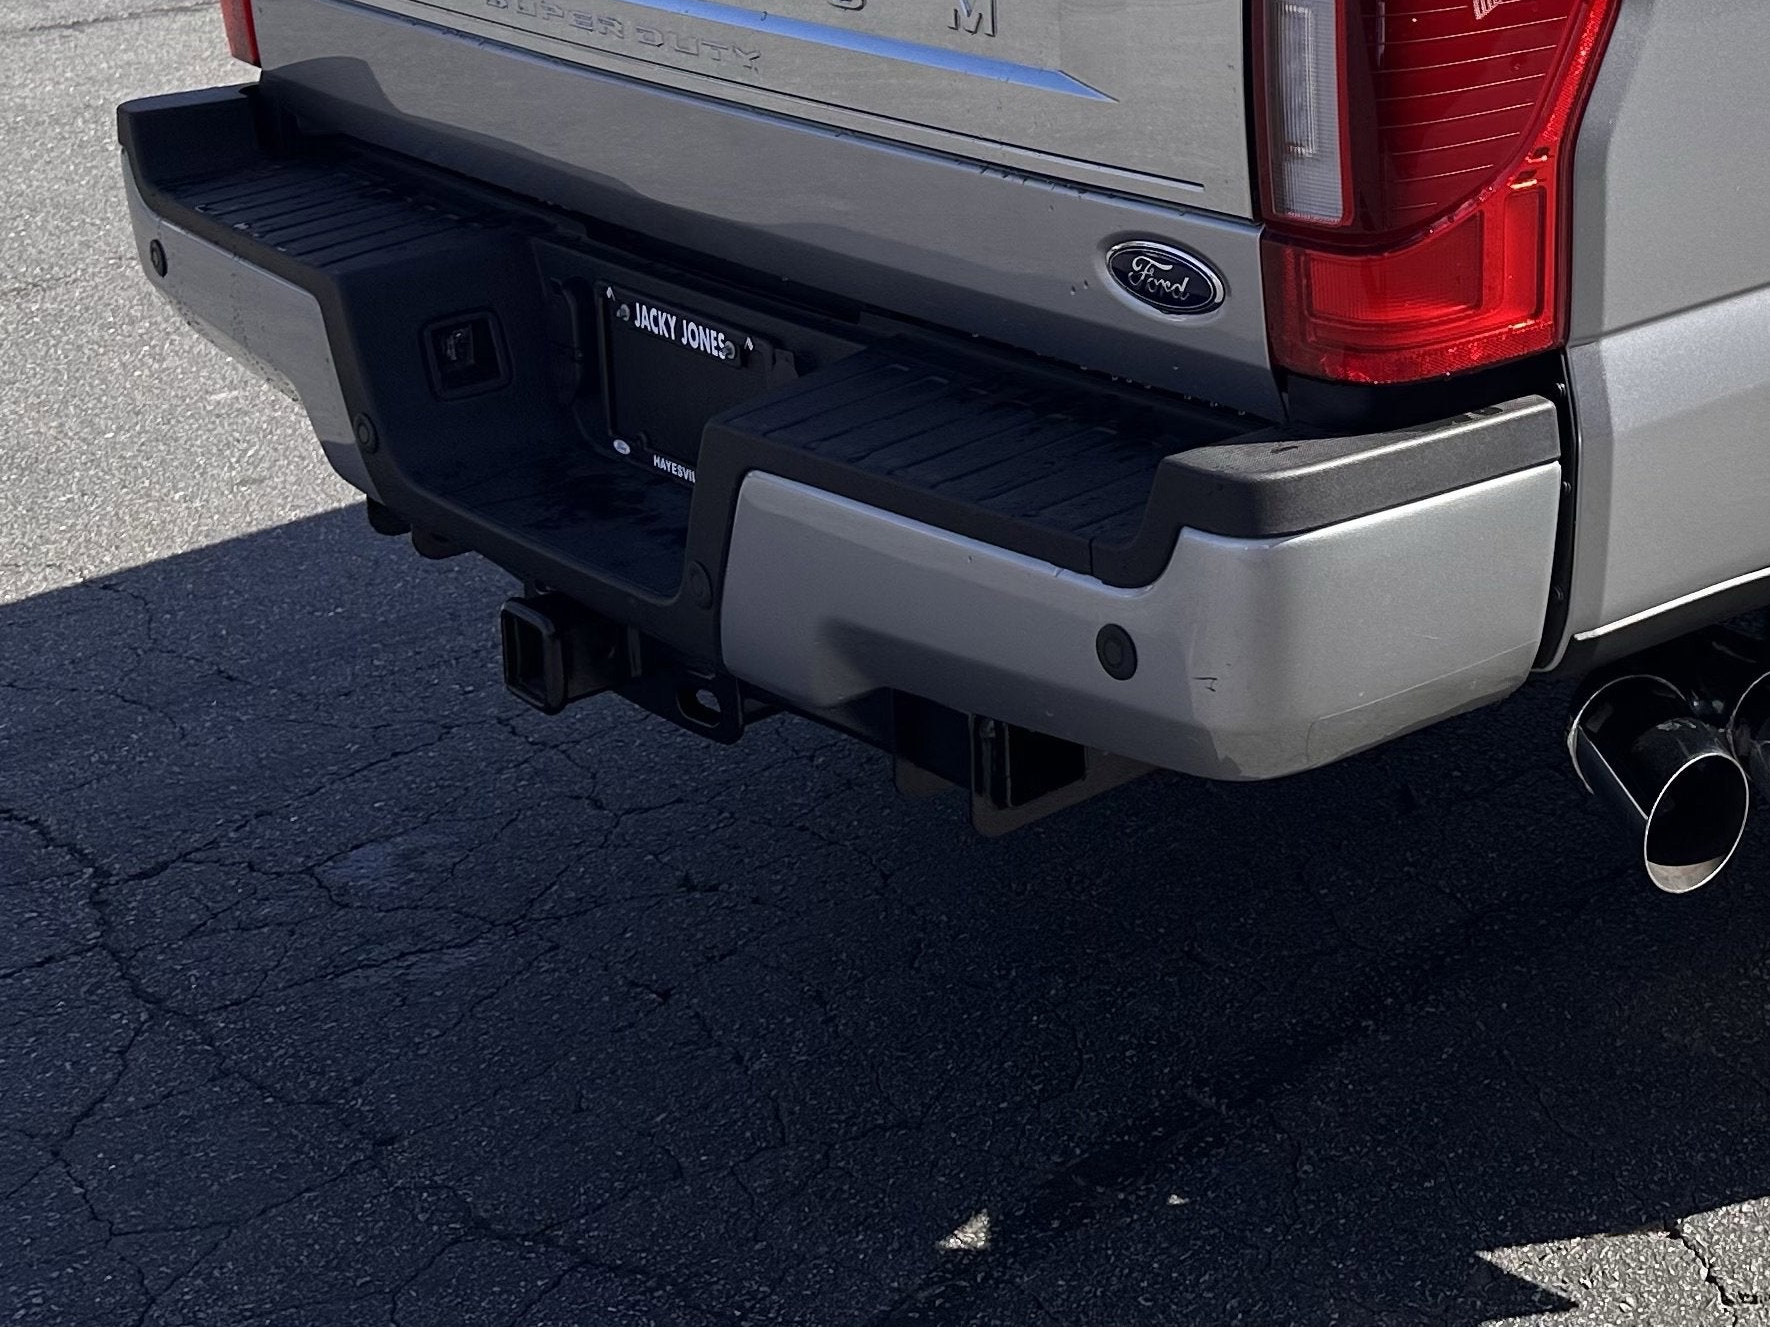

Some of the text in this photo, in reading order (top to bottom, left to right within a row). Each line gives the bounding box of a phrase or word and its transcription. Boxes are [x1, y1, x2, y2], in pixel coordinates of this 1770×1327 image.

[635, 25, 762, 70] DUTY
[1128, 255, 1190, 301] Ford
[634, 302, 727, 360] JACKY JONES
